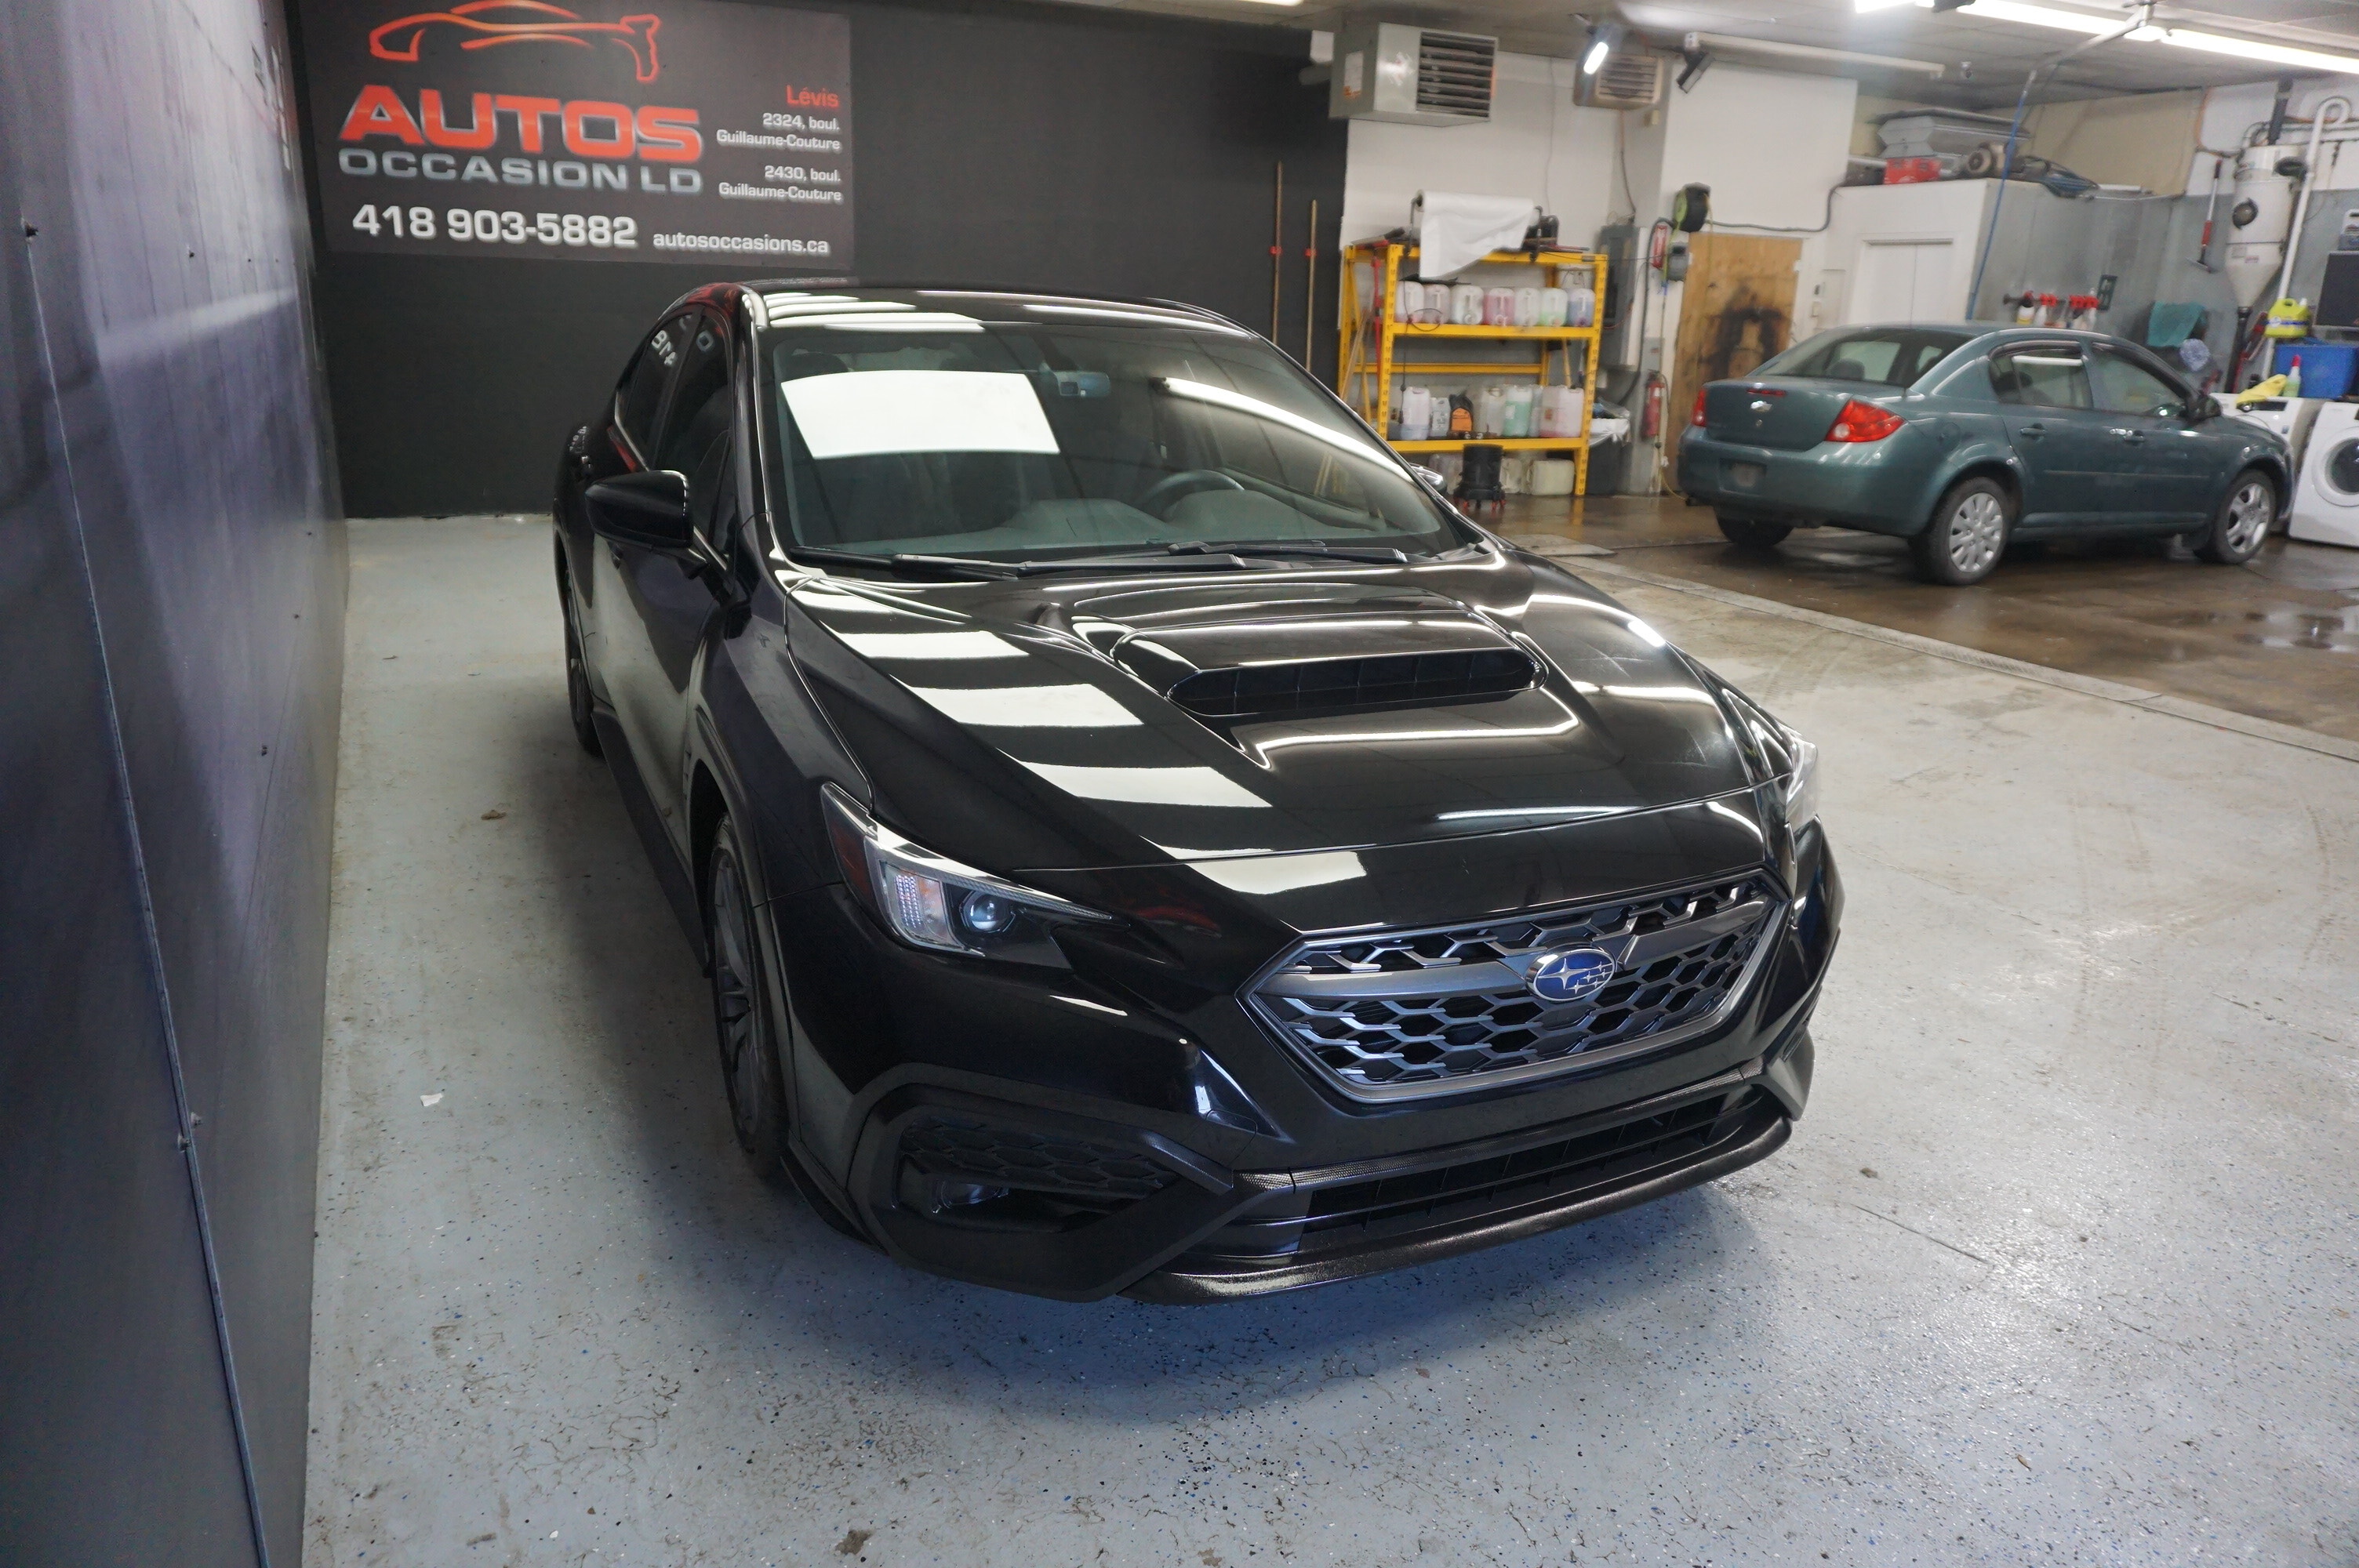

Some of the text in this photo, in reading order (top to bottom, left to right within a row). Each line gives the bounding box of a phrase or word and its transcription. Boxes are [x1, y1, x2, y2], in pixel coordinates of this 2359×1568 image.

[786, 85, 840, 108] Lévis
[339, 84, 703, 162] AUTOS
[762, 112, 841, 131] 2324, boul.
[717, 129, 841, 151] Guillaume-Couture
[339, 147, 702, 194] OCCASION LD
[764, 165, 841, 183] 2430, boul.
[718, 182, 842, 203] Guillaume-Couture
[351, 204, 638, 246] 418 903-5882
[652, 231, 830, 254] autosoccasions.ca
